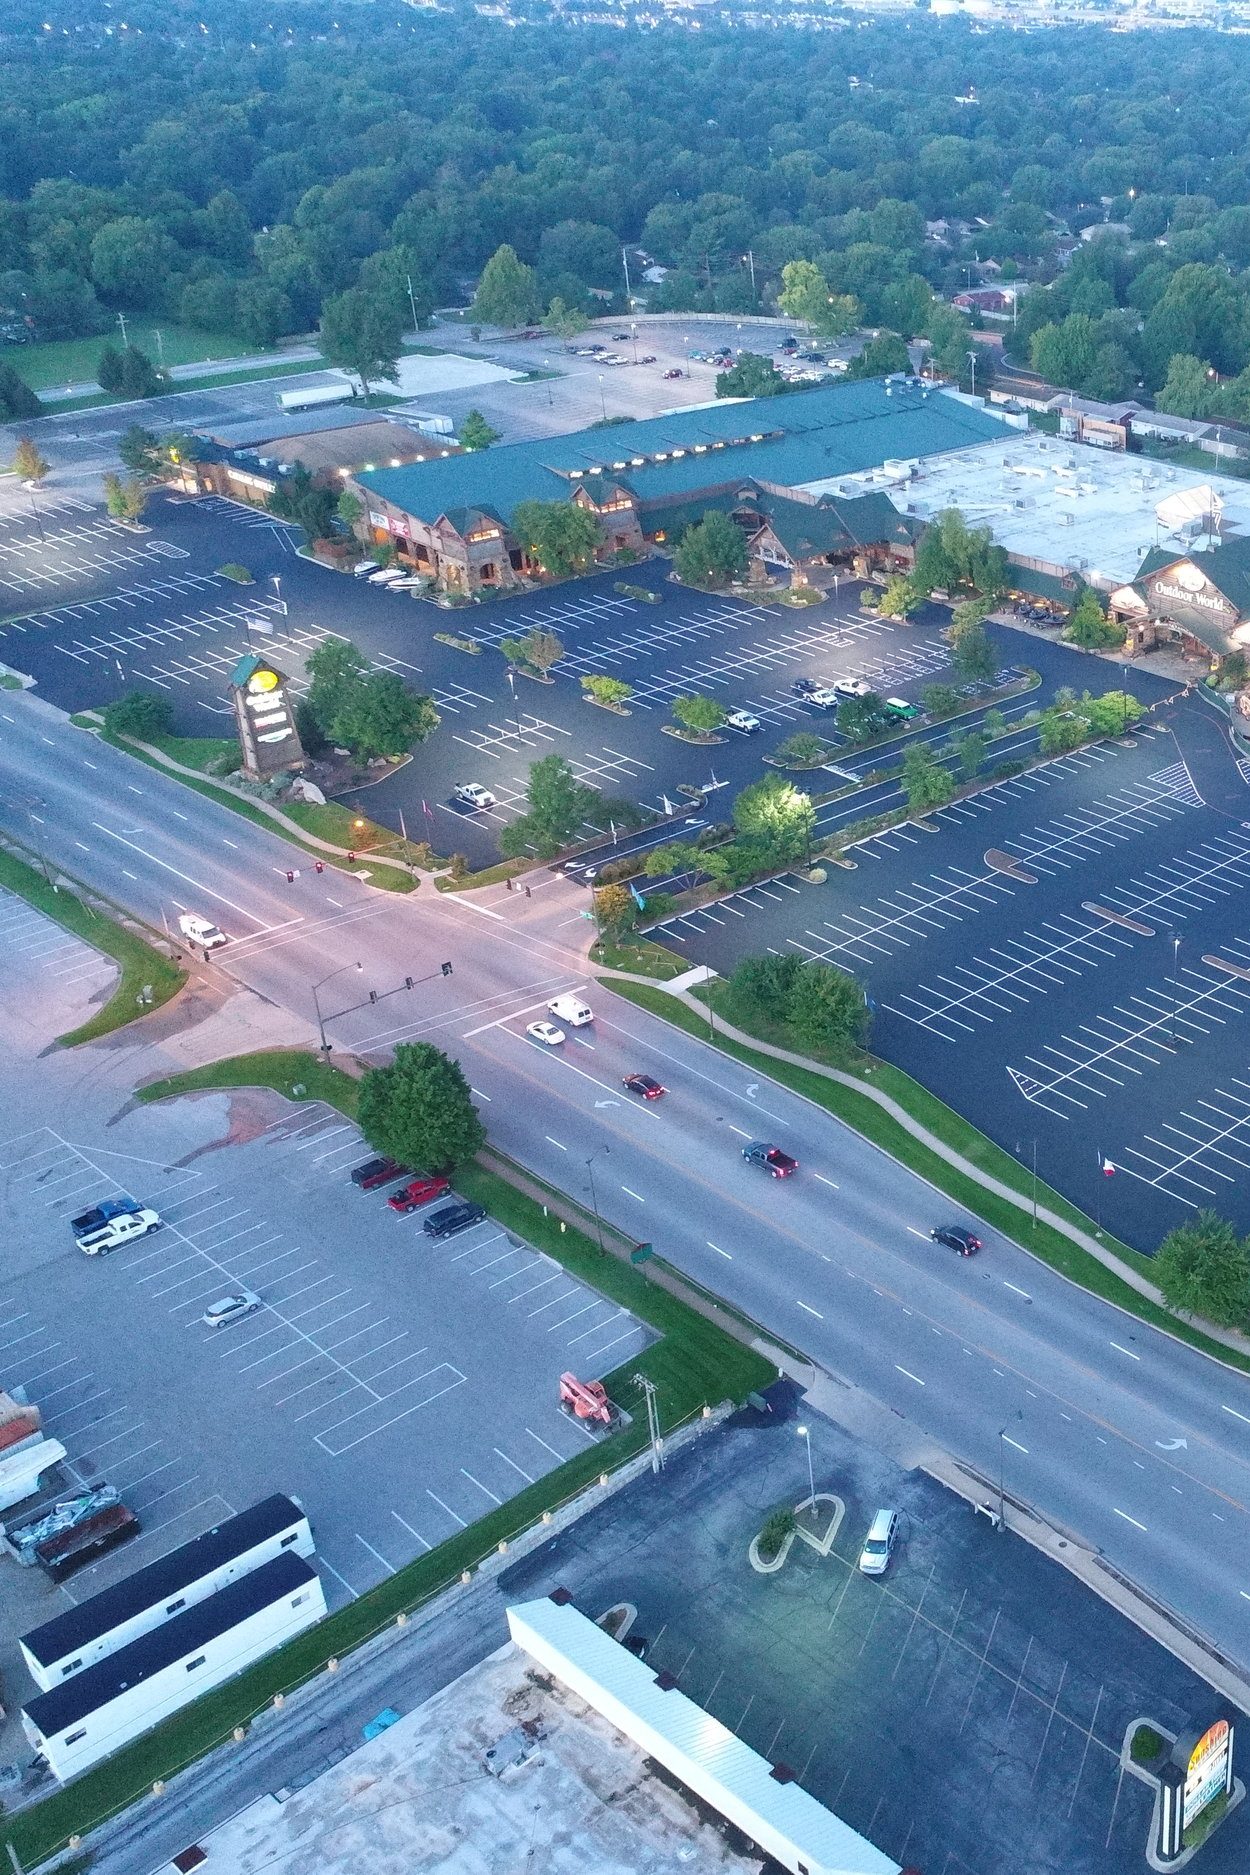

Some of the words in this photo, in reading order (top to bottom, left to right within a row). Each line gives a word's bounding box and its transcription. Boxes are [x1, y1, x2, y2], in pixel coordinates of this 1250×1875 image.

[1155, 582, 1194, 602] Outdoor
[1196, 592, 1223, 611] World
[1189, 1725, 1227, 1771] Sunshine
